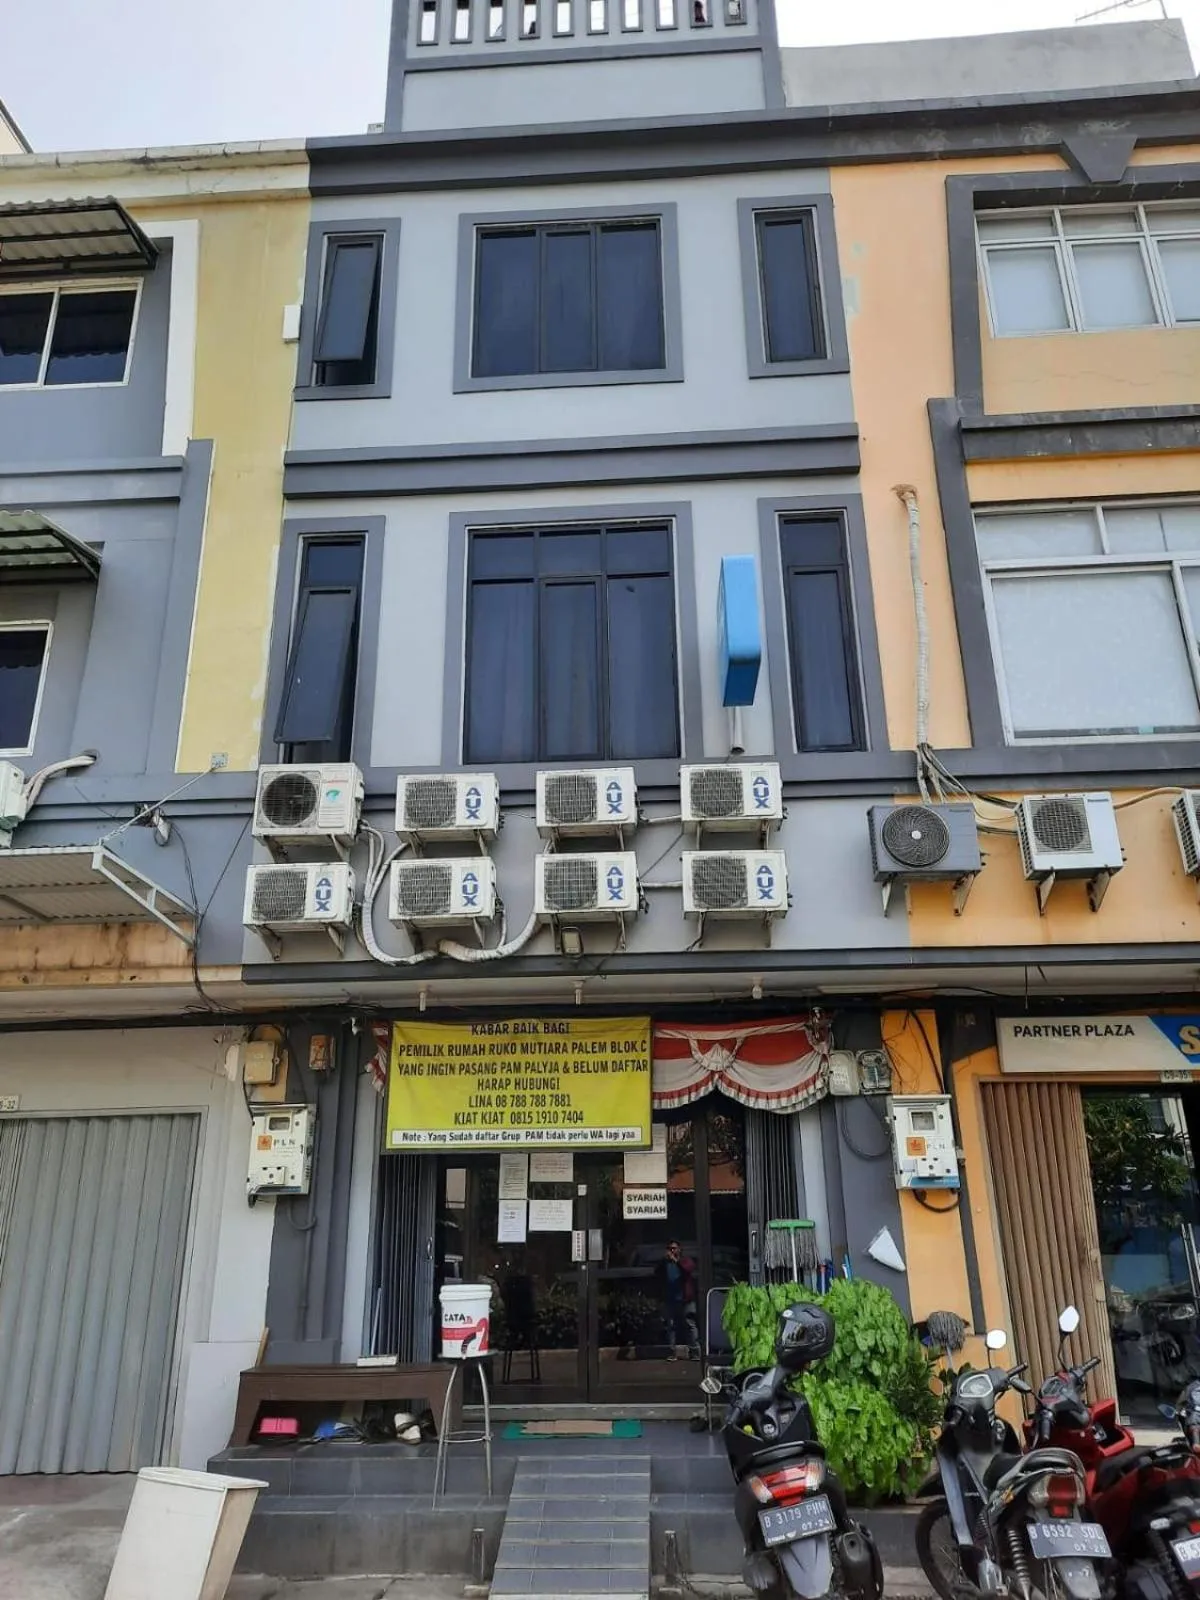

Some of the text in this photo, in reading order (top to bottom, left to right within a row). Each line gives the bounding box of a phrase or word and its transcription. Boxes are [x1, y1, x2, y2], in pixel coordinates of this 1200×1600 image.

[606, 781, 623, 814] AUX
[752, 776, 770, 809] AUX
[465, 787, 482, 820] AUX
[461, 872, 478, 907] AUX
[606, 866, 624, 900] AUX
[756, 865, 775, 899] AUX
[315, 877, 332, 912] AUX
[471, 1022, 570, 1036] KABAR BAIK BAGI
[1013, 1024, 1135, 1037] PARTNER PLAZA
[399, 1043, 444, 1057] PEMILIK
[447, 1043, 486, 1056] RUMAH
[489, 1042, 517, 1055] RUKO
[520, 1041, 569, 1055] MUTIARA
[571, 1040, 607, 1054] PALEM
[398, 1059, 649, 1077] YANG INGIN PASANG PAM PALYJA & BELUM DAFTAR
[477, 1077, 560, 1091] HARAP HUBUNGI
[468, 1094, 572, 1108] LINA 08 788 788 7881
[454, 1110, 584, 1125] KIAT KIAT 0815 1910 7404
[402, 1131, 421, 1141] Note
[428, 1132, 448, 1143] Yang
[449, 1131, 473, 1141] Sudah
[475, 1131, 500, 1141] daftar
[501, 1131, 521, 1142] Grup
[525, 1131, 544, 1141] PAM
[546, 1130, 567, 1140] tidak
[590, 1130, 604, 1140] WA
[606, 1130, 620, 1141] lagi
[622, 1131, 636, 1141] yaa
[626, 1193, 666, 1202] SYARIAH
[626, 1206, 666, 1214] SYARIAH
[764, 1516, 772, 1529] B
[1030, 1527, 1038, 1540] B
